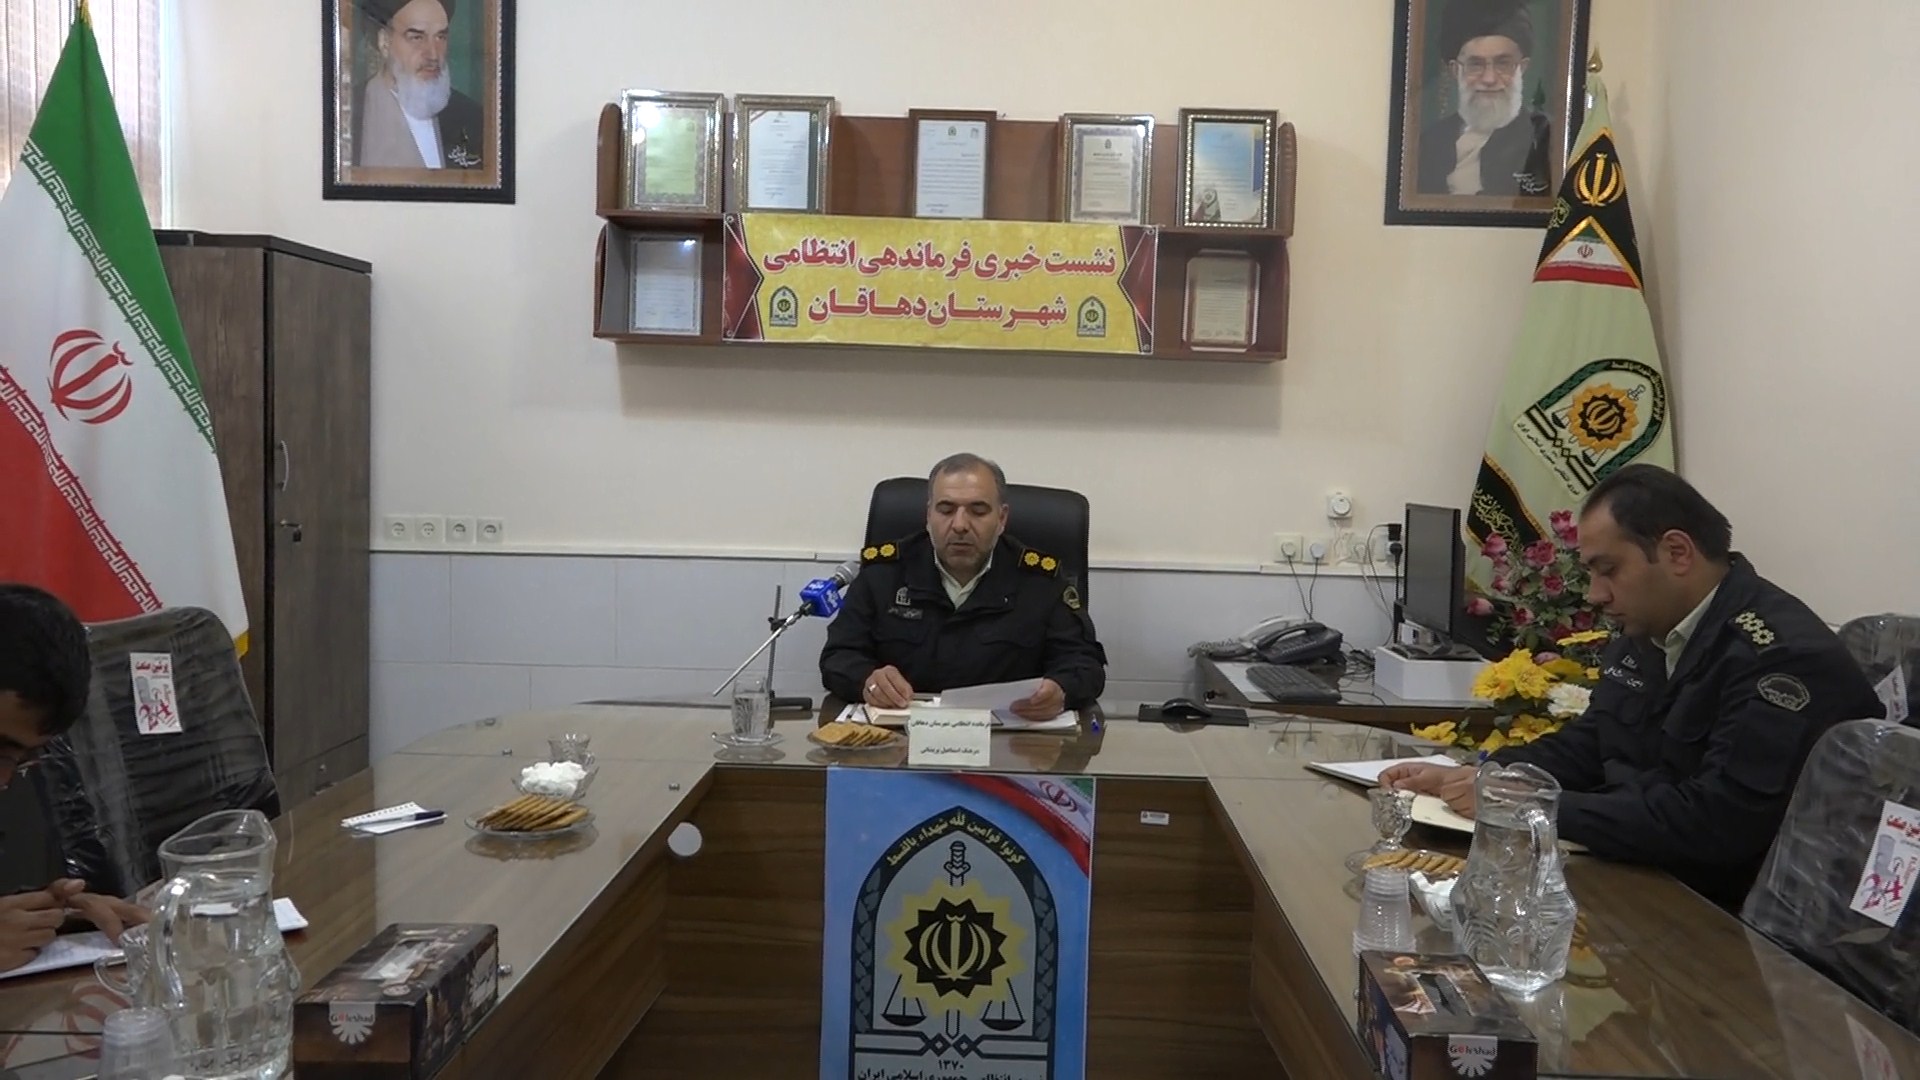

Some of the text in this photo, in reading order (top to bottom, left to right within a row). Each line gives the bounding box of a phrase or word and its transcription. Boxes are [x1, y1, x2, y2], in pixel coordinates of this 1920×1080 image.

[764, 237, 1116, 279] نشست خبری فرماندهی انتظامی
[809, 287, 1067, 329] شهرستان دهاقان
[938, 1060, 964, 1070] ۱۳۷۰
